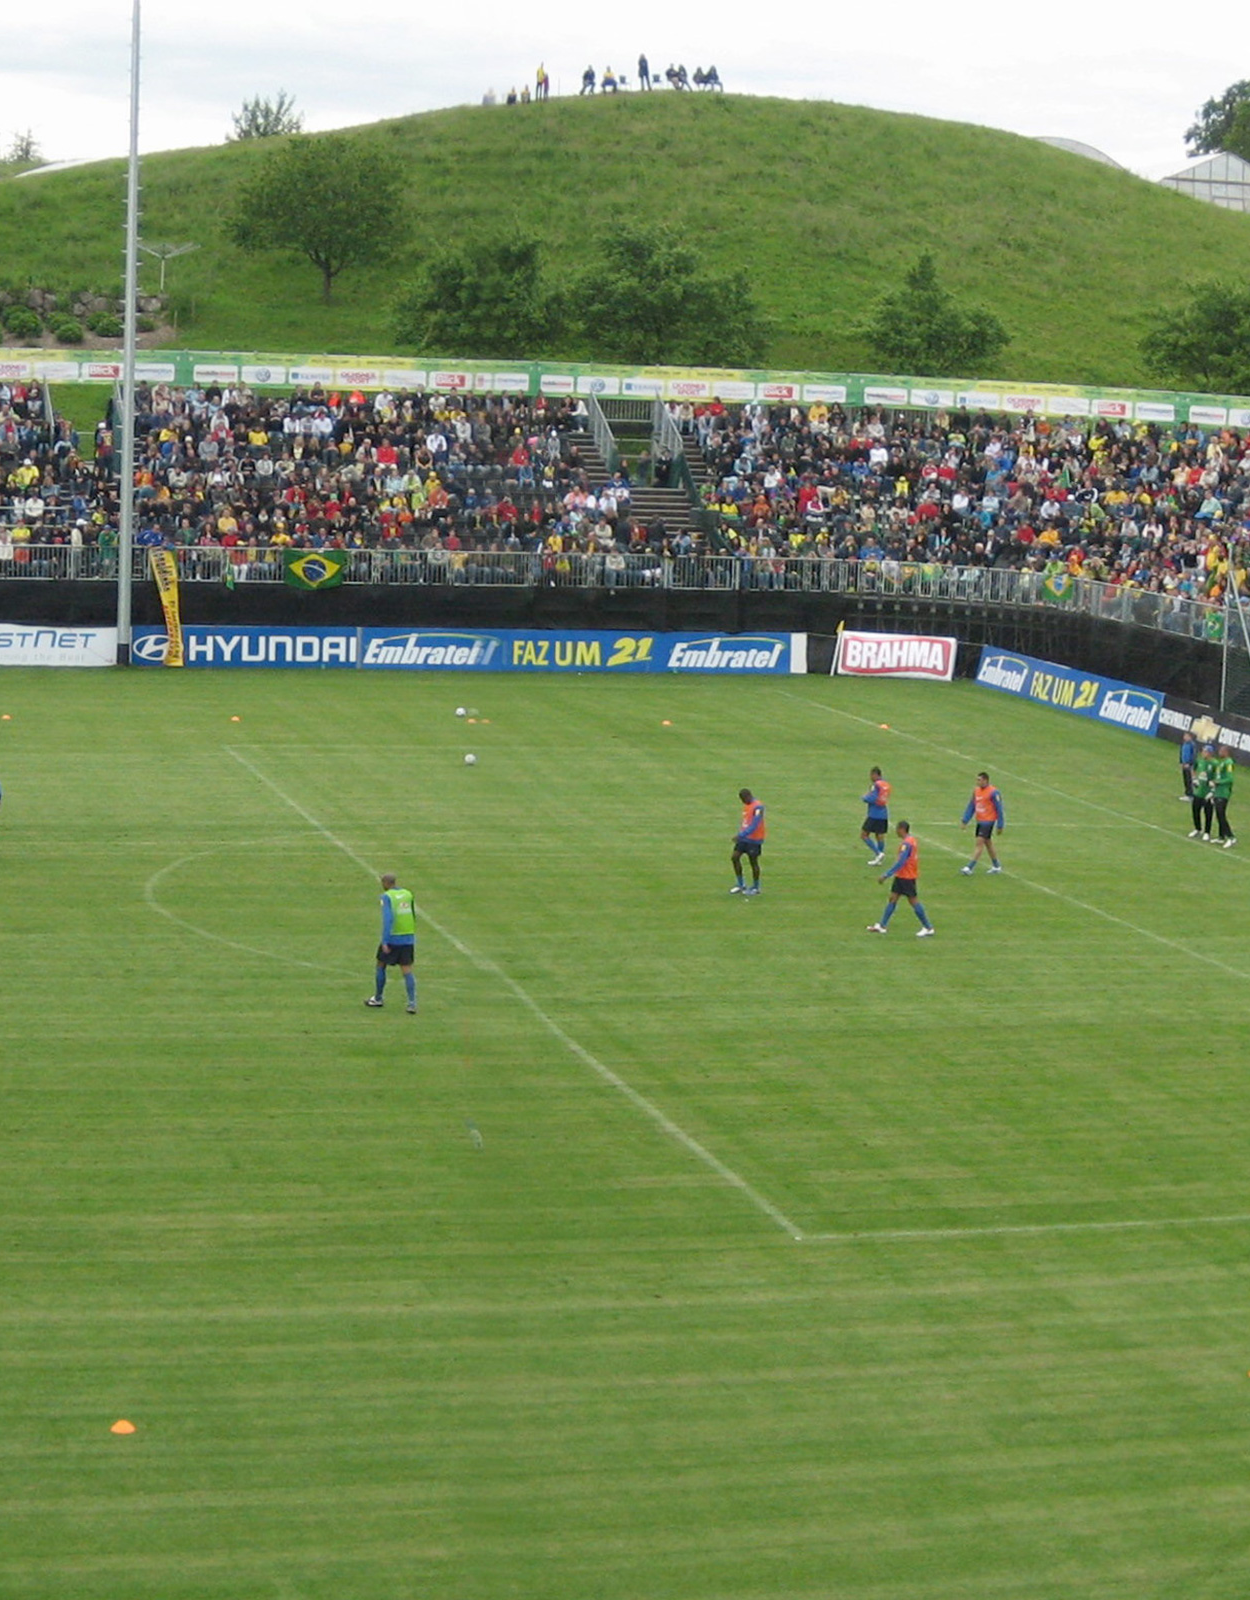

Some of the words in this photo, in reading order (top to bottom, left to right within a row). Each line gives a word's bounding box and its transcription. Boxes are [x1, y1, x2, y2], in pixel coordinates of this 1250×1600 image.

[188, 636, 357, 662] HYUNDAI
[513, 640, 549, 666] FAZ
[555, 641, 601, 666] UM
[606, 637, 653, 667] 21
[667, 637, 785, 668] Embratel
[845, 639, 944, 671] BRAHMA
[978, 656, 1029, 693] Embratel
[1030, 671, 1053, 701] FAZ
[1052, 677, 1076, 708] UM
[1073, 681, 1099, 709] 21
[1099, 690, 1158, 731] Embratel
